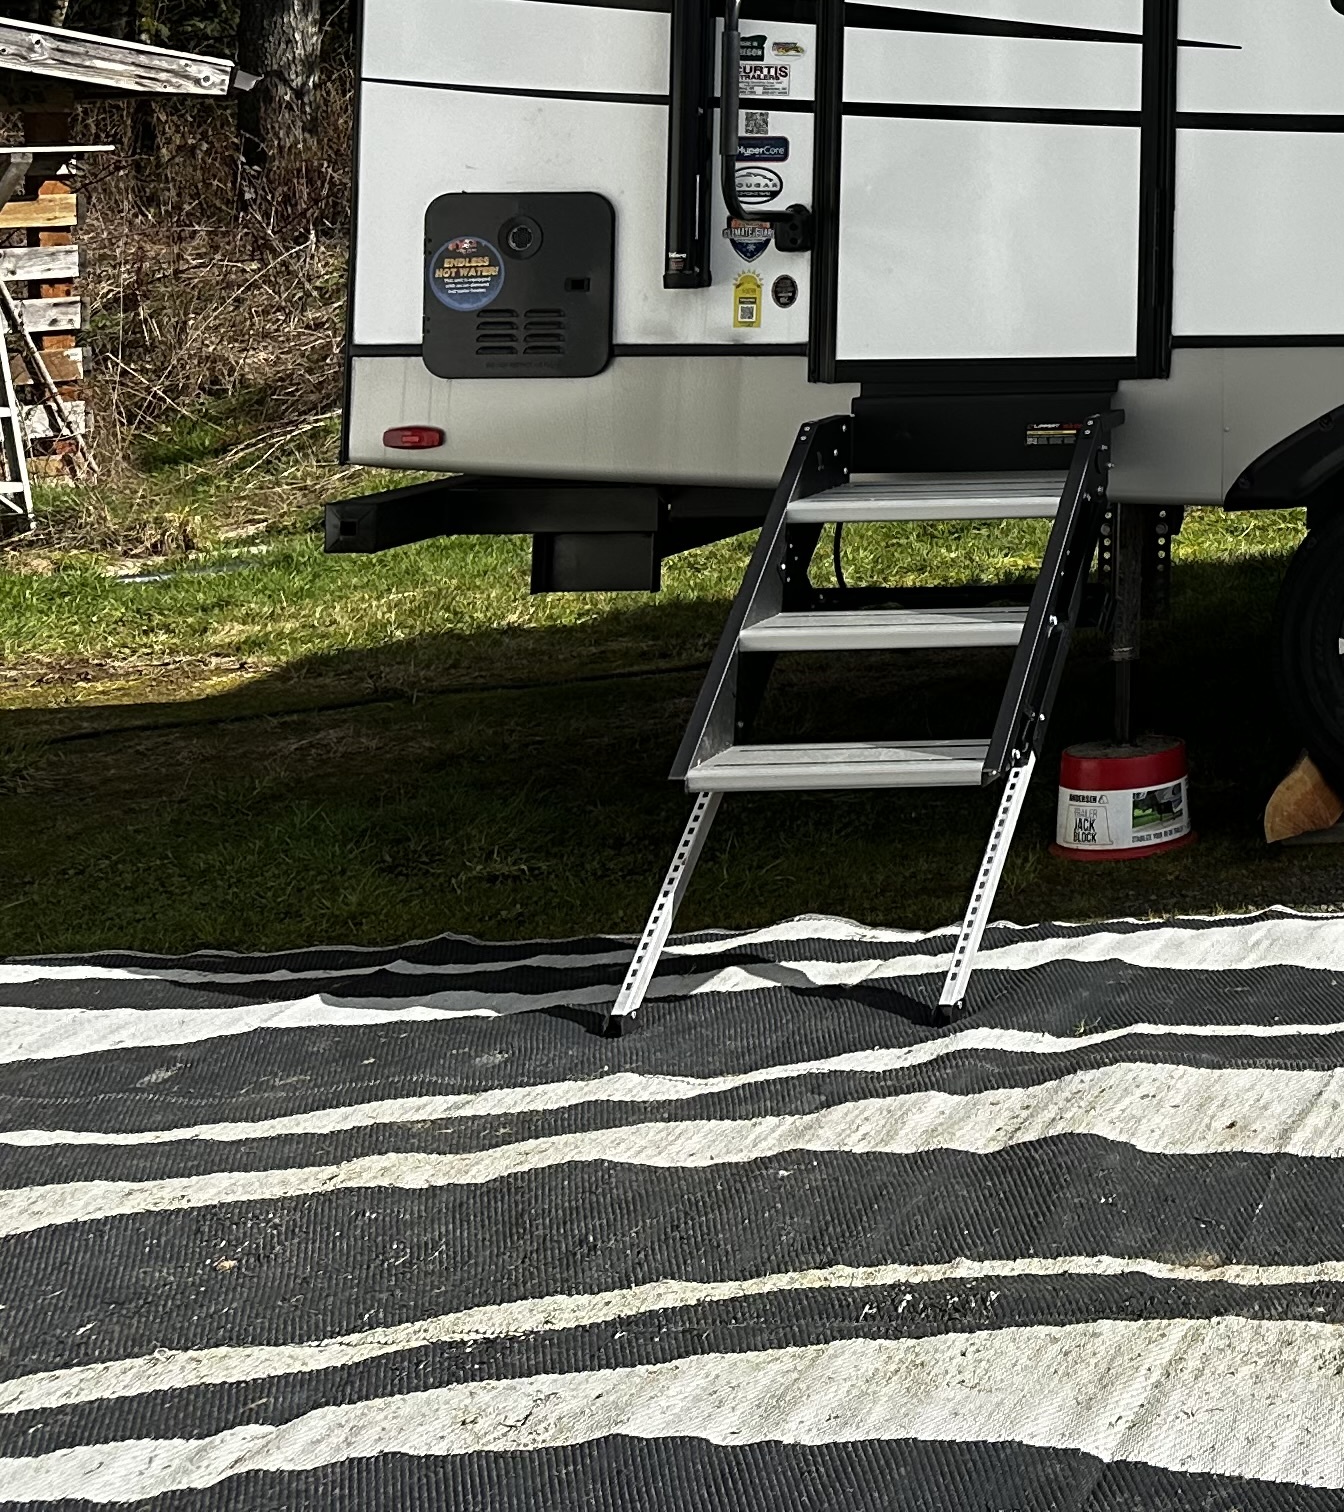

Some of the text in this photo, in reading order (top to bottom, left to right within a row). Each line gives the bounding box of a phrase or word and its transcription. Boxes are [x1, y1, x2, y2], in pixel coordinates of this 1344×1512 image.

[444, 257, 489, 267] ENDLESS
[435, 268, 457, 277] HOT
[1074, 808, 1098, 818] TRAILER
[1074, 818, 1096, 832] JACK
[1073, 831, 1097, 843] BLOCK
